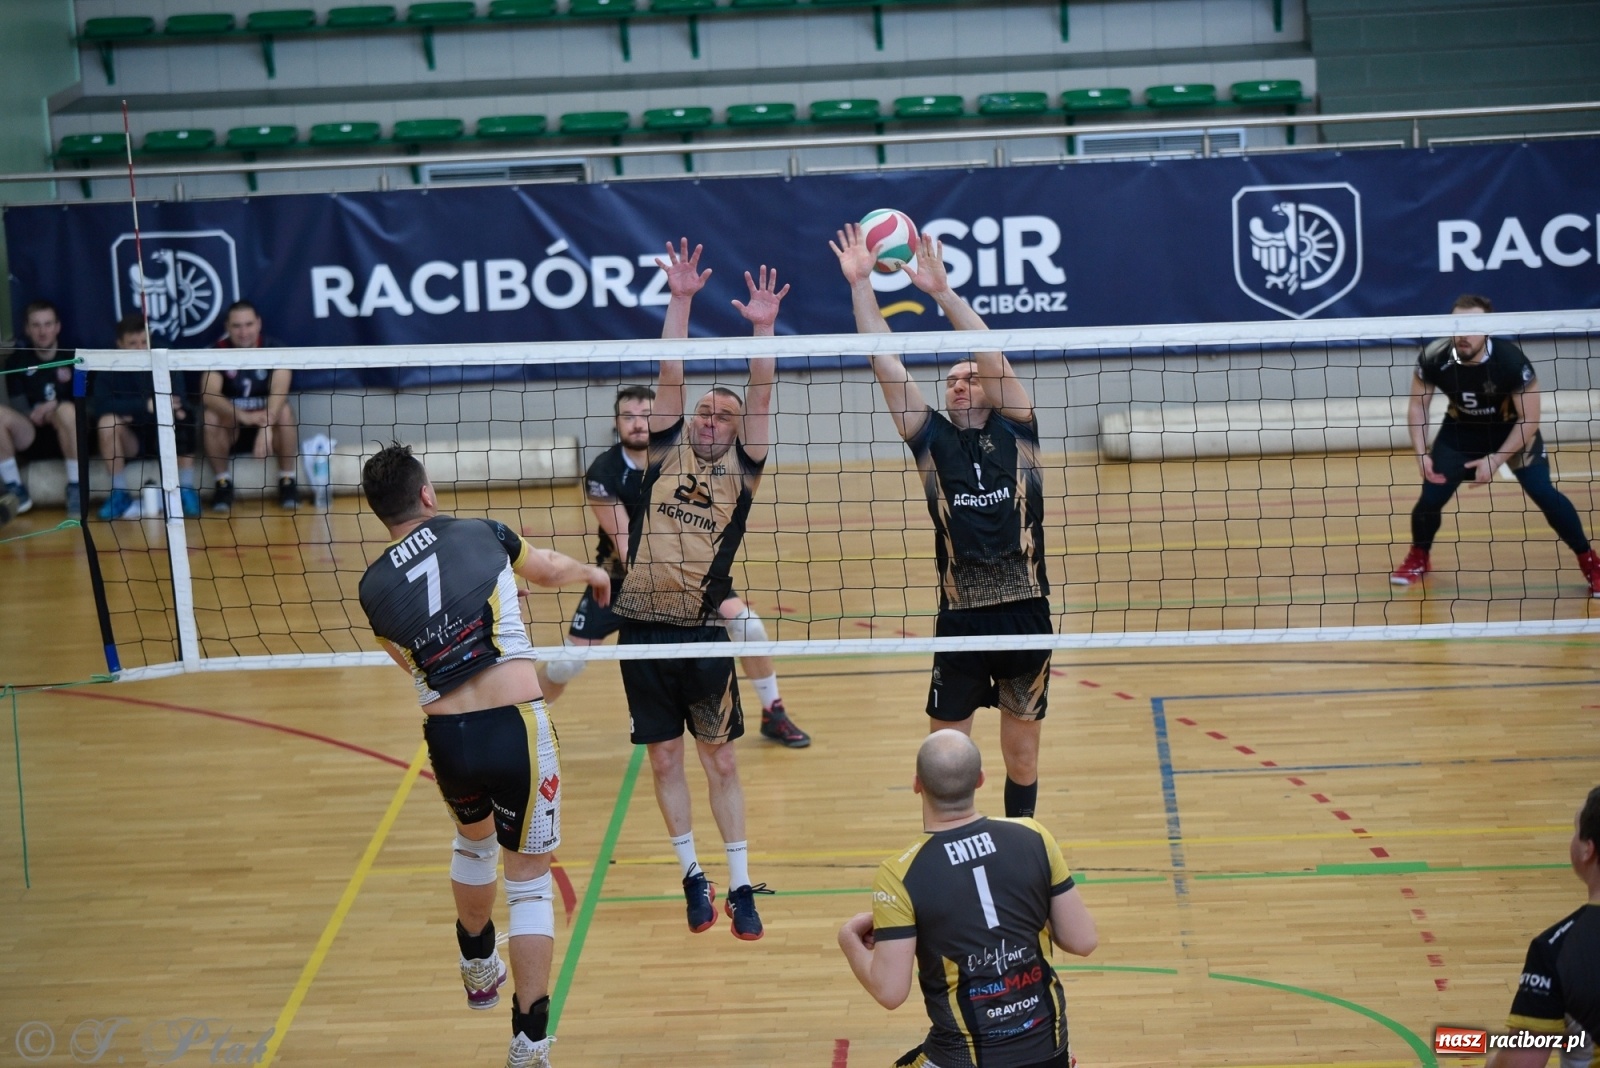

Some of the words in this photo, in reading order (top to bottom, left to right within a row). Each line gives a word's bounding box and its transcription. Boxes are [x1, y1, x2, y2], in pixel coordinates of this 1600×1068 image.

[869, 216, 1067, 292] SiR
[311, 238, 681, 318] RACIBÓRZ
[938, 288, 1068, 316] CIBÓRZ
[1462, 392, 1478, 408] 5
[674, 473, 713, 509] 23
[953, 486, 1010, 507] AGROTIM
[657, 502, 717, 533] AGROTIM
[389, 527, 438, 568] ENTER
[405, 552, 442, 617] 7
[933, 688, 939, 708] 1
[943, 831, 997, 865] ENTER
[972, 865, 1000, 929] 1
[986, 995, 1039, 1019] GRAVTON
